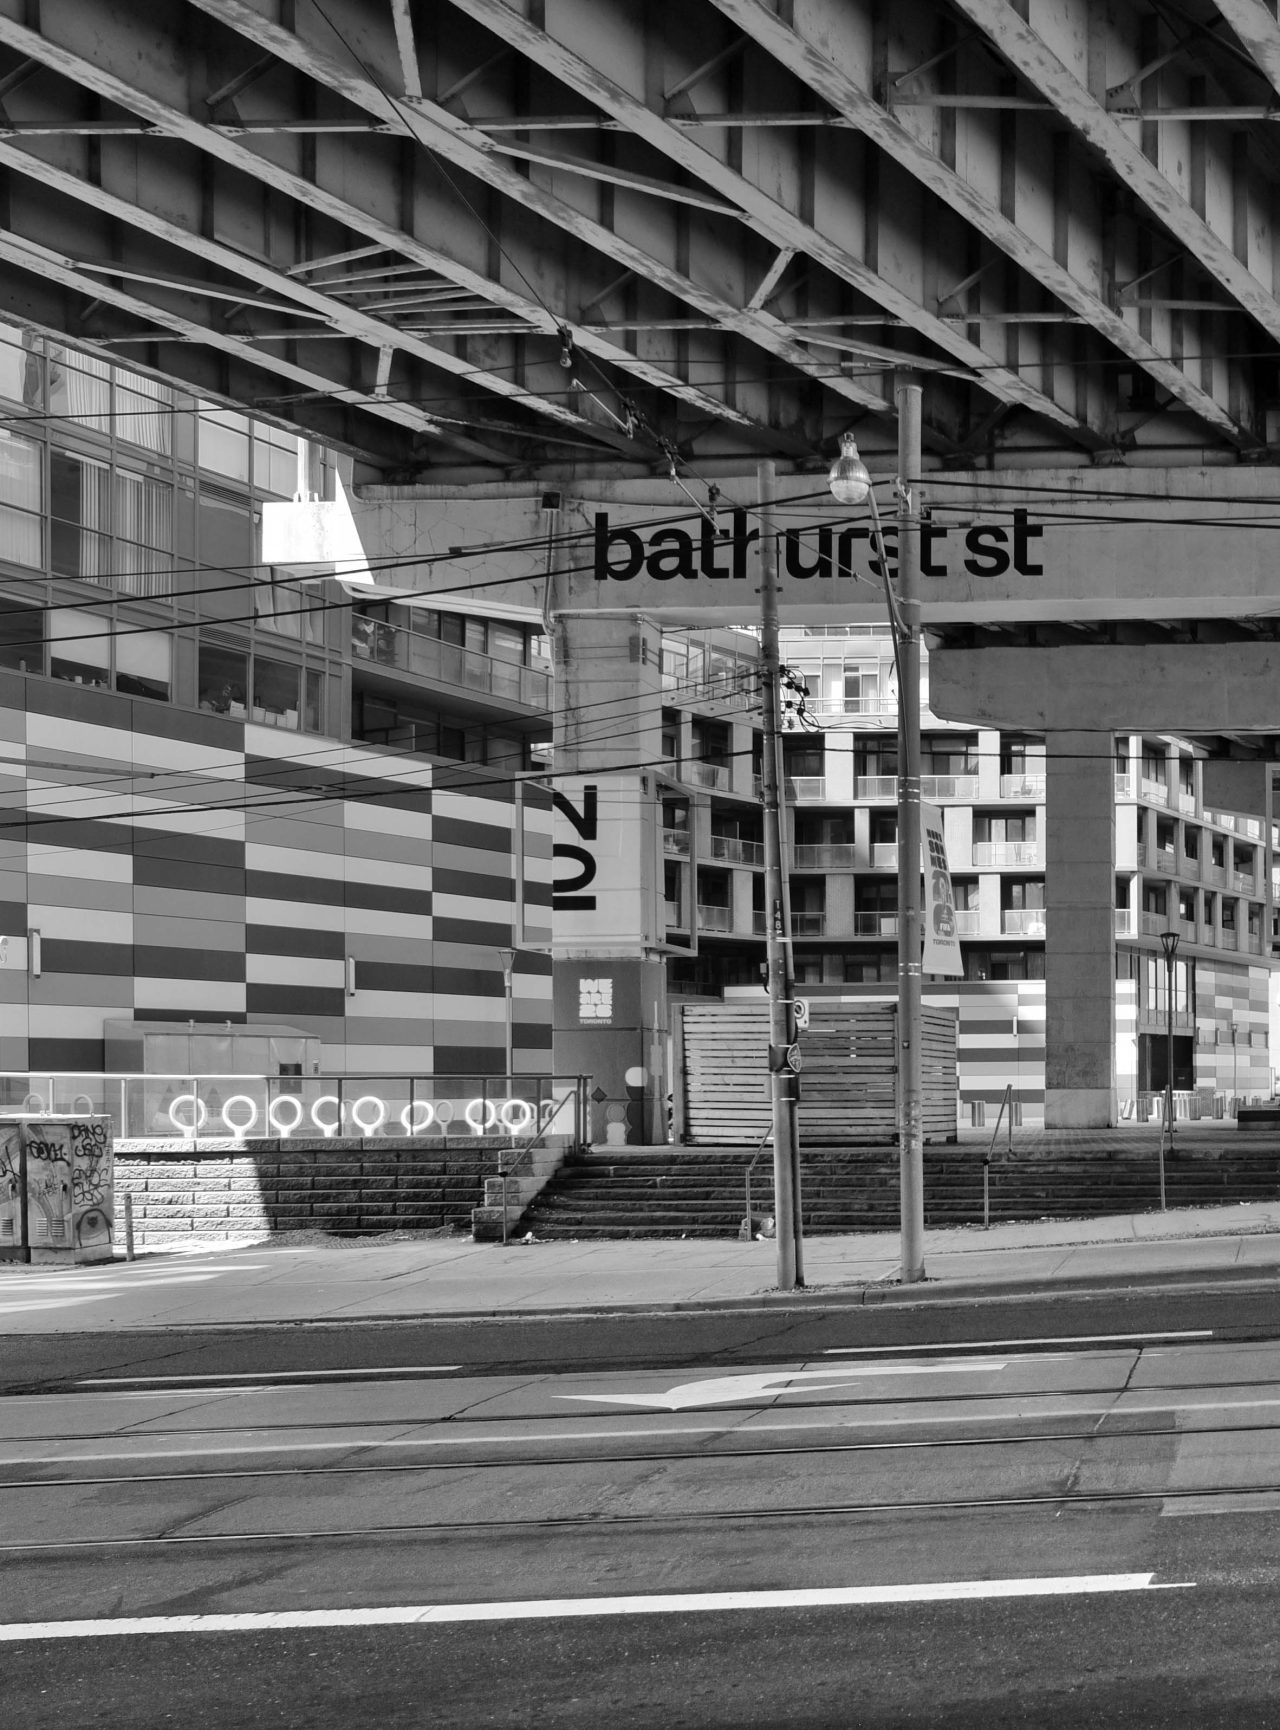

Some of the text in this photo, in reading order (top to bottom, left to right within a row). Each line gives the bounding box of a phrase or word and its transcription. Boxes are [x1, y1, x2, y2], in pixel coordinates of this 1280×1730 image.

[595, 508, 1043, 581] bathurst st
[579, 978, 613, 994] WE
